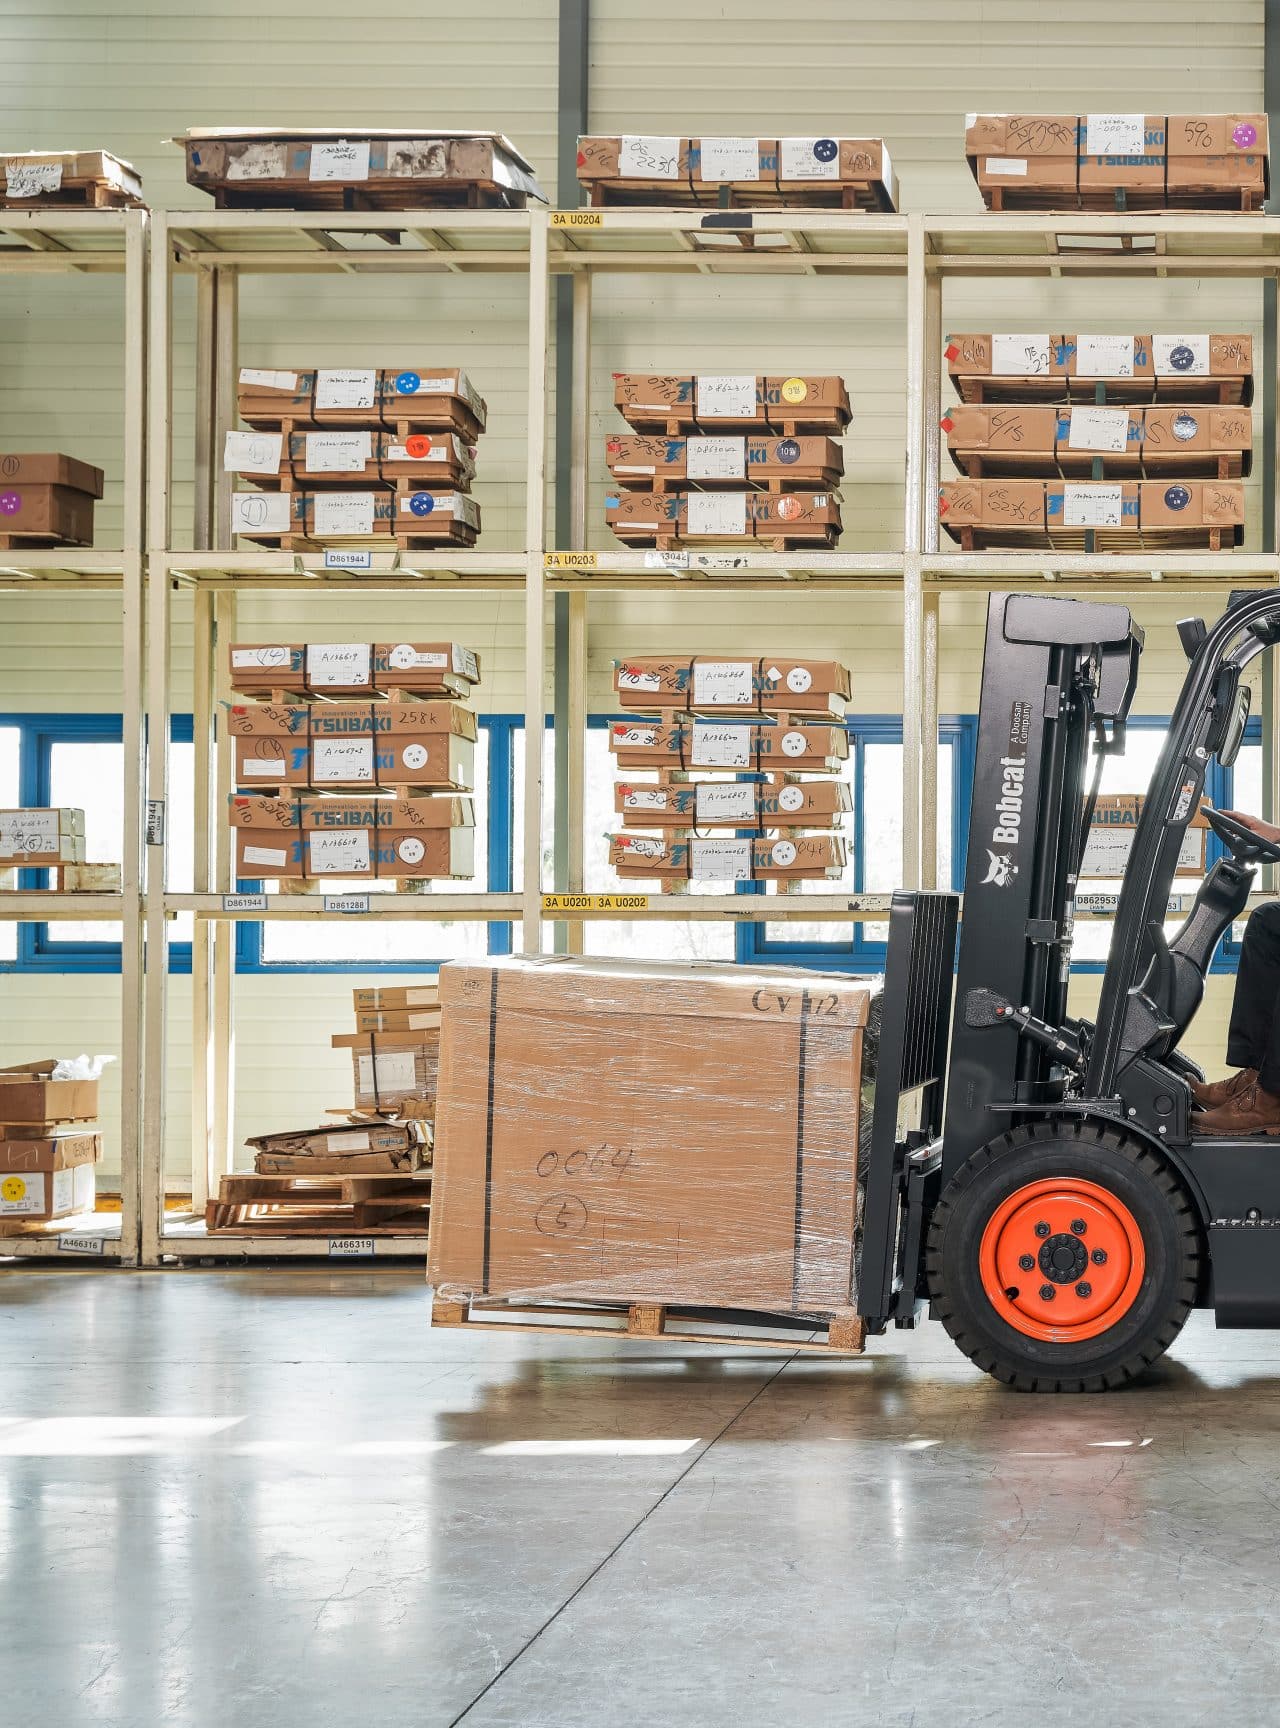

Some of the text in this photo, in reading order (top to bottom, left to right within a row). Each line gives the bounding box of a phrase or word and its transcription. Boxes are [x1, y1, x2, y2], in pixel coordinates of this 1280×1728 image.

[553, 214, 600, 225] 3A U0204
[329, 555, 365, 563] D861944
[547, 556, 595, 565] 3A U0203
[1010, 701, 1023, 736] Doosan
[1018, 701, 1033, 745] Company
[311, 717, 392, 732] TSUBAKI
[993, 756, 1026, 844] Bobcat
[311, 811, 392, 826] TSUBAKI
[545, 897, 646, 907] 3A U0201 3A U0202
[1077, 896, 1117, 904] D862953
[331, 1240, 372, 1249] A466319
